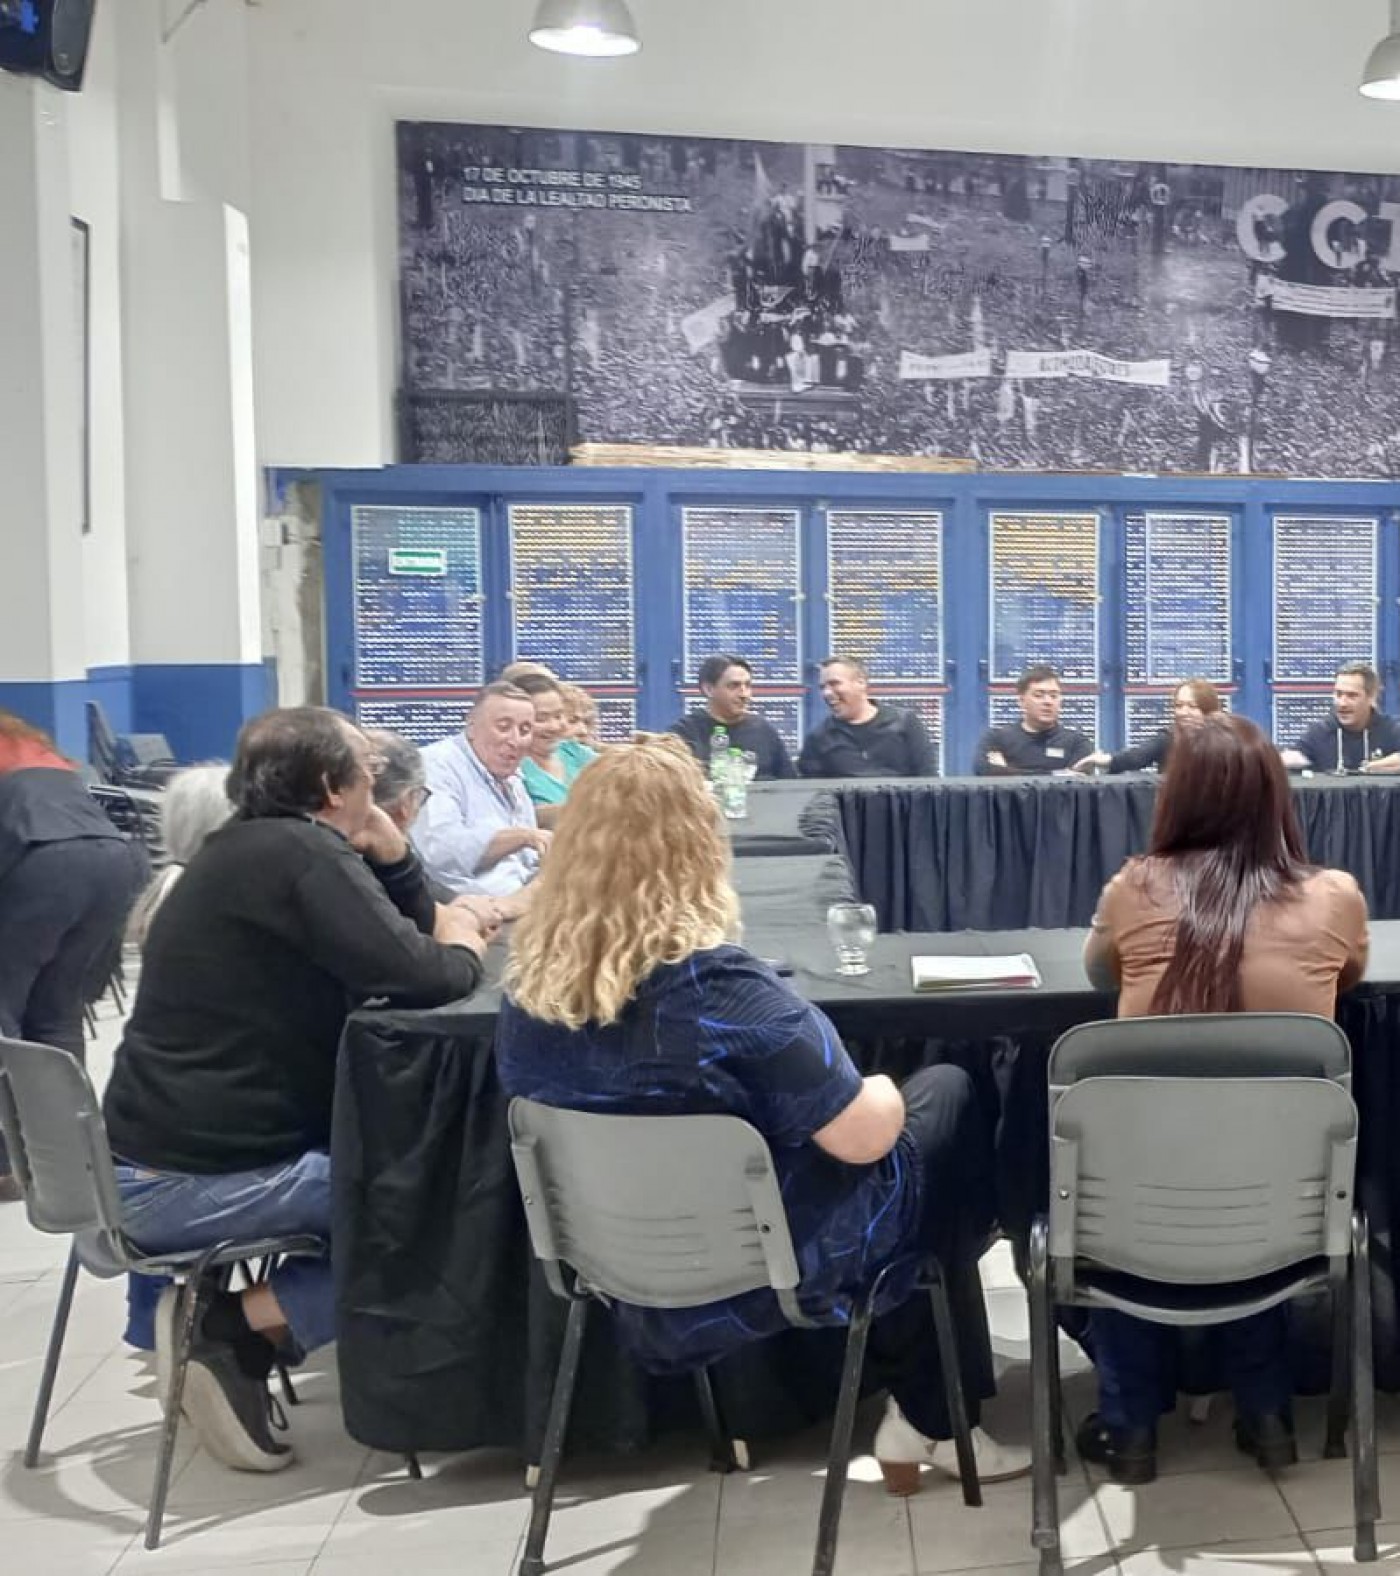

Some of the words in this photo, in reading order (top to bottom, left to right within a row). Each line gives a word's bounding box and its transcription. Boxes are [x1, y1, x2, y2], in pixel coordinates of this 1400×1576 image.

[463, 167, 480, 182] 17
[482, 168, 506, 184] DE
[507, 169, 581, 187] OCTUBRE
[583, 172, 606, 188] DE
[491, 188, 515, 204] DE
[516, 189, 537, 205] LA
[609, 193, 694, 212] PERONISTA
